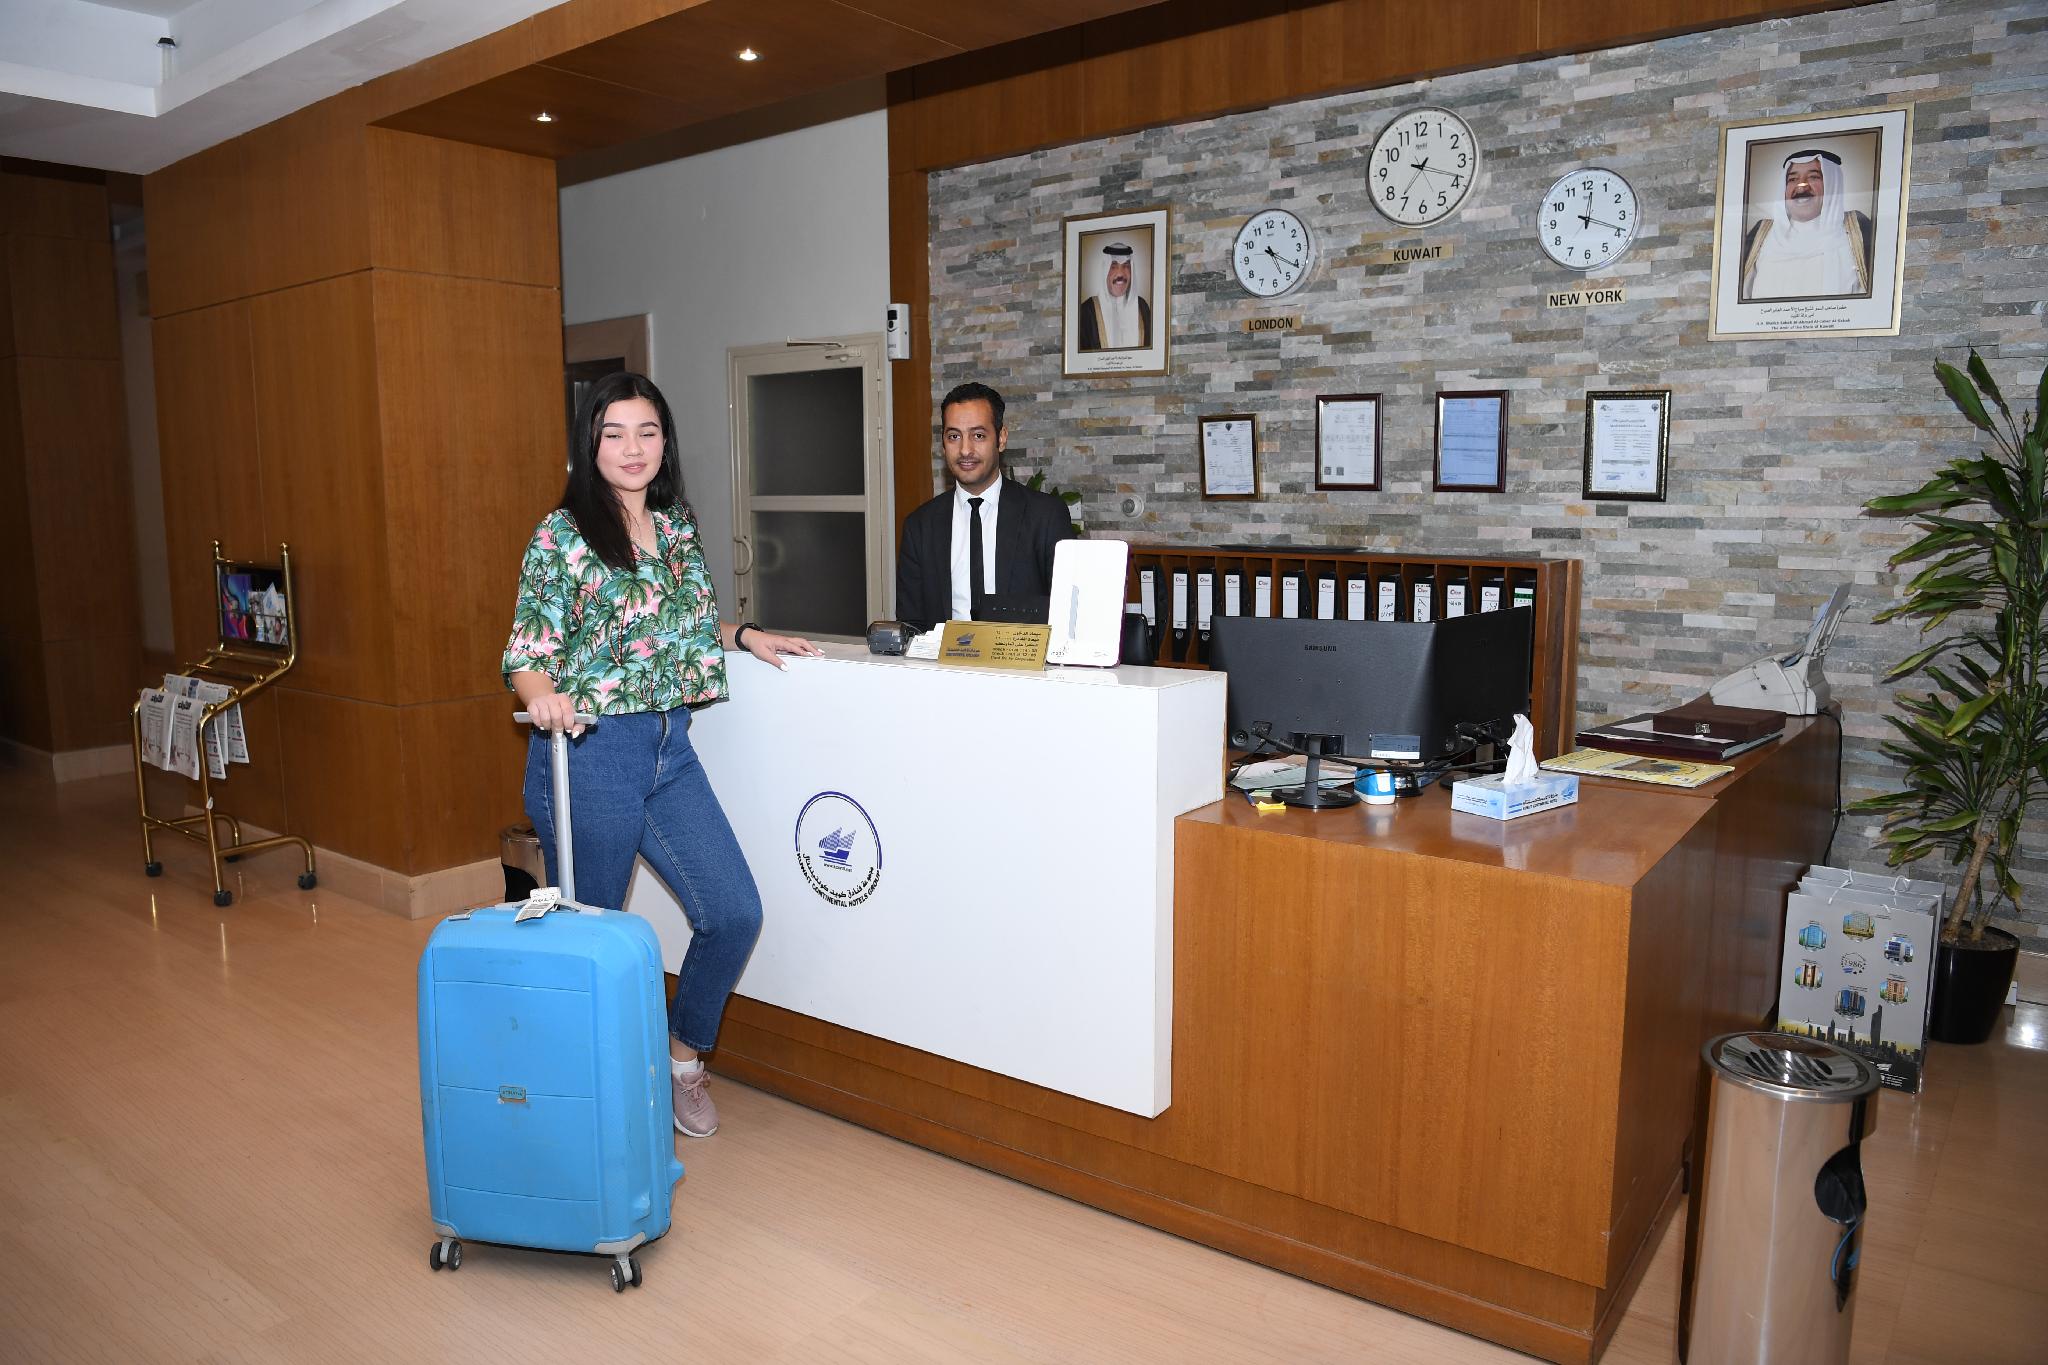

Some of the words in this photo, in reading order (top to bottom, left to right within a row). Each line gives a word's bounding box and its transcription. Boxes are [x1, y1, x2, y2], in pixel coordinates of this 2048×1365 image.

[1414, 121, 1428, 138] 12
[1437, 122, 1442, 138] 1
[1398, 130, 1410, 147] 11
[1450, 134, 1459, 150] 2
[1385, 147, 1400, 164] 10
[1457, 153, 1467, 168] 3
[1379, 167, 1388, 183] 9
[1450, 174, 1460, 189] 4
[1581, 180, 1594, 191] 12
[1602, 182, 1608, 192] 1
[1386, 185, 1395, 201] 8
[1437, 190, 1447, 207] 5
[1565, 188, 1576, 198] 11
[1614, 193, 1621, 204] 2
[1400, 196, 1409, 212] 7
[1418, 200, 1428, 215] 6
[1553, 201, 1565, 212] 10
[1618, 210, 1626, 221] 3
[1265, 220, 1275, 230] 12
[1280, 220, 1286, 230] 1
[1549, 219, 1557, 230] 9
[1253, 227, 1262, 237] 11
[1290, 228, 1297, 238] 2
[1245, 240, 1254, 251] 10
[1554, 235, 1562, 246] 8
[1295, 242, 1302, 252] 3
[1567, 246, 1574, 257] 7
[1601, 242, 1609, 253] 5
[1393, 246, 1442, 261] KUWAIT
[1584, 249, 1591, 260] 6
[1243, 256, 1250, 265] 9
[1248, 269, 1255, 279] 8
[1285, 271, 1291, 281] 5
[1258, 278, 1265, 287] 7
[1272, 278, 1278, 288] 6
[1549, 292, 1580, 307] NEW
[1585, 290, 1622, 304] YORK
[1249, 317, 1293, 331] LONDON
[848, 892, 868, 907] HOTELS
[868, 870, 880, 895] GROUP
